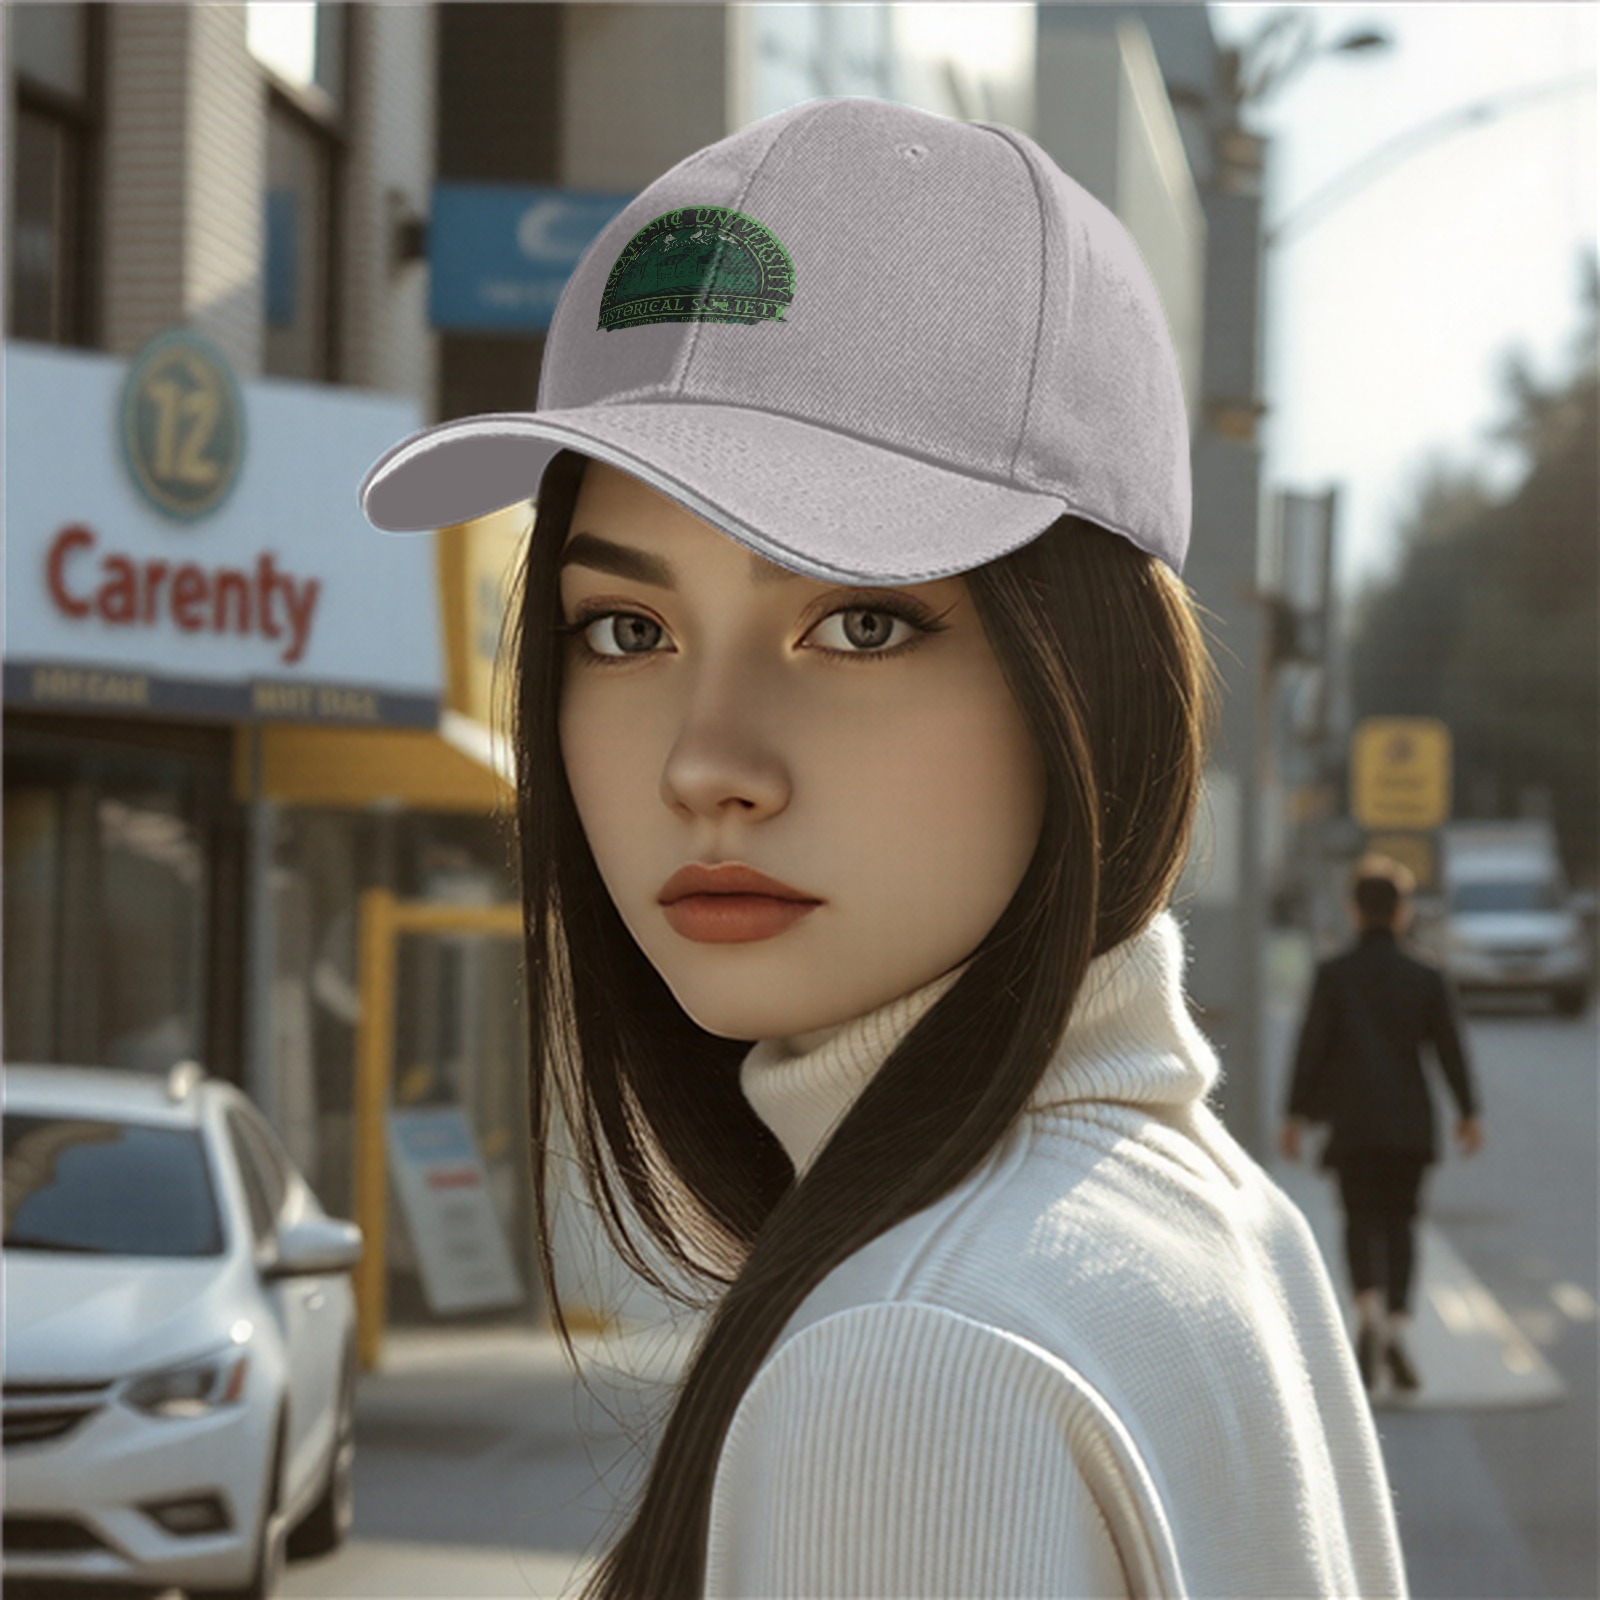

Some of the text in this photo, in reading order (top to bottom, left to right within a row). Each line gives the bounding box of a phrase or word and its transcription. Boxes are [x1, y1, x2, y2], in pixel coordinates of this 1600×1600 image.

[695, 208, 790, 298] UNIVERSITY
[599, 298, 685, 326] HISTORICAL
[45, 521, 323, 667] Carenty
